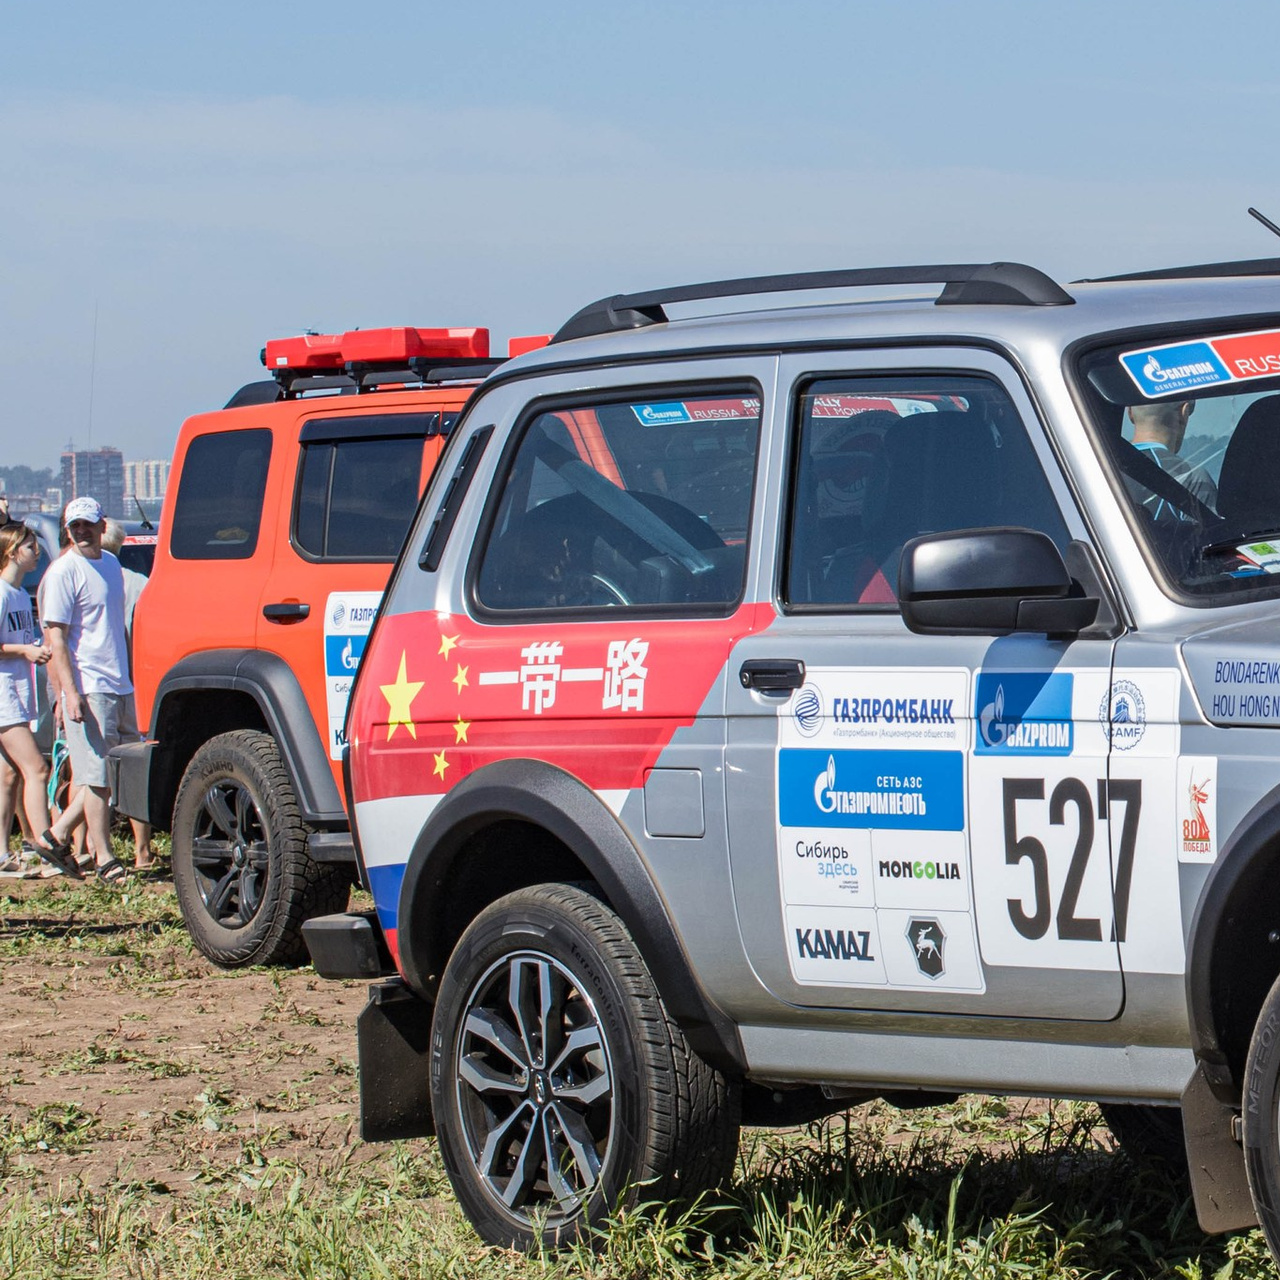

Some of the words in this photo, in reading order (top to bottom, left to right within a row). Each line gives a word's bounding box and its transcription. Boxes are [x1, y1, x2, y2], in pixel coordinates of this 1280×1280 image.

[1165, 361, 1215, 380] GAZPROM
[1154, 381, 1187, 392] GENERAL
[1188, 373, 1220, 385] PARTNER
[694, 408, 740, 419] RUSSIA
[479, 638, 649, 715] 一带一路
[833, 698, 955, 724] ГАЗПРОМБАНК
[1212, 694, 1236, 717] HOU
[1239, 695, 1271, 718] HONG
[1007, 723, 1069, 747] GAZPROM
[876, 776, 901, 788] СЕТЬ
[903, 776, 923, 788] АЗС
[836, 791, 926, 816] ГАЗПРОМНЕФТЬ
[1183, 819, 1198, 839] 80
[795, 841, 849, 863] Сибирь
[1183, 842, 1211, 853] ПОБЕДА!
[818, 862, 858, 879] здесь
[879, 860, 961, 880] MONGOLIA
[1002, 777, 1142, 943] 527
[796, 928, 875, 962] KAMAZ
[1248, 1010, 1280, 1115] METEOR
